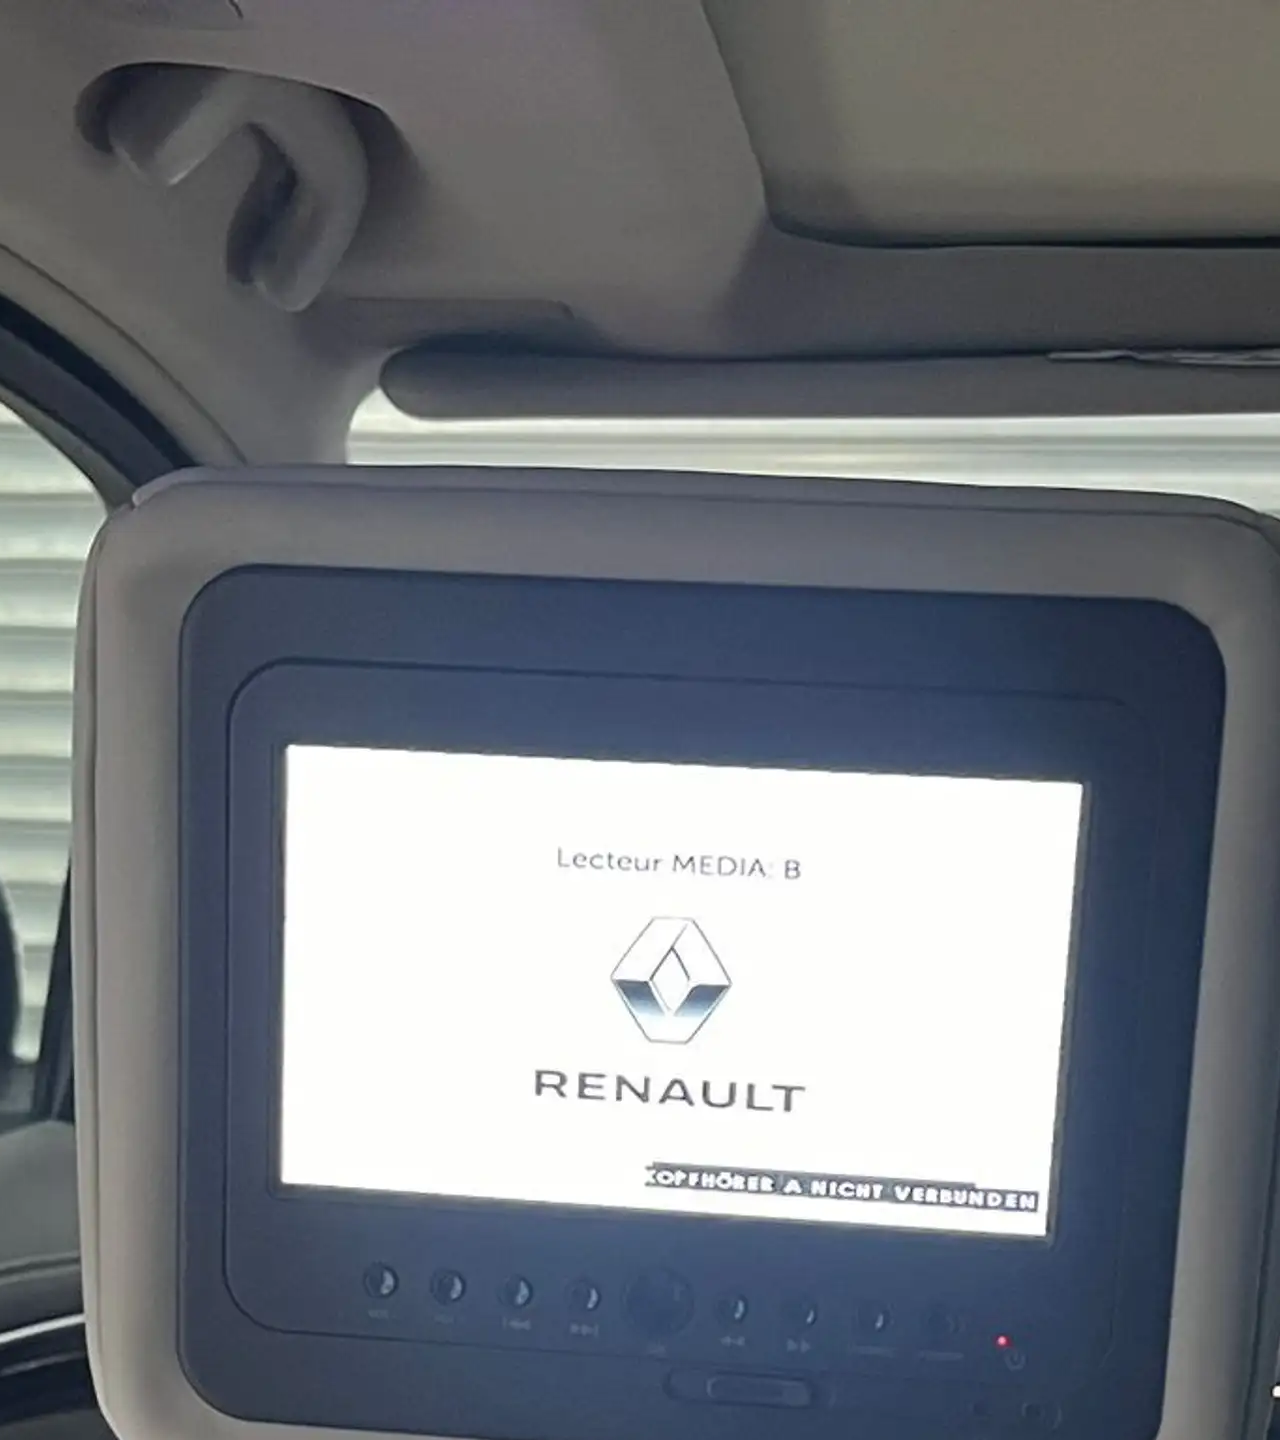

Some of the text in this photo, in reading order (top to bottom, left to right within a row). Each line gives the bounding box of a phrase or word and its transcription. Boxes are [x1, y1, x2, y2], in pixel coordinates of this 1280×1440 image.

[556, 846, 663, 872] Lecteur
[783, 858, 802, 881] B
[534, 1068, 807, 1113] RENAULT
[783, 1178, 803, 1195] A
[810, 1180, 884, 1200] NICHT
[893, 1184, 1036, 1210] VERBUNDEN
